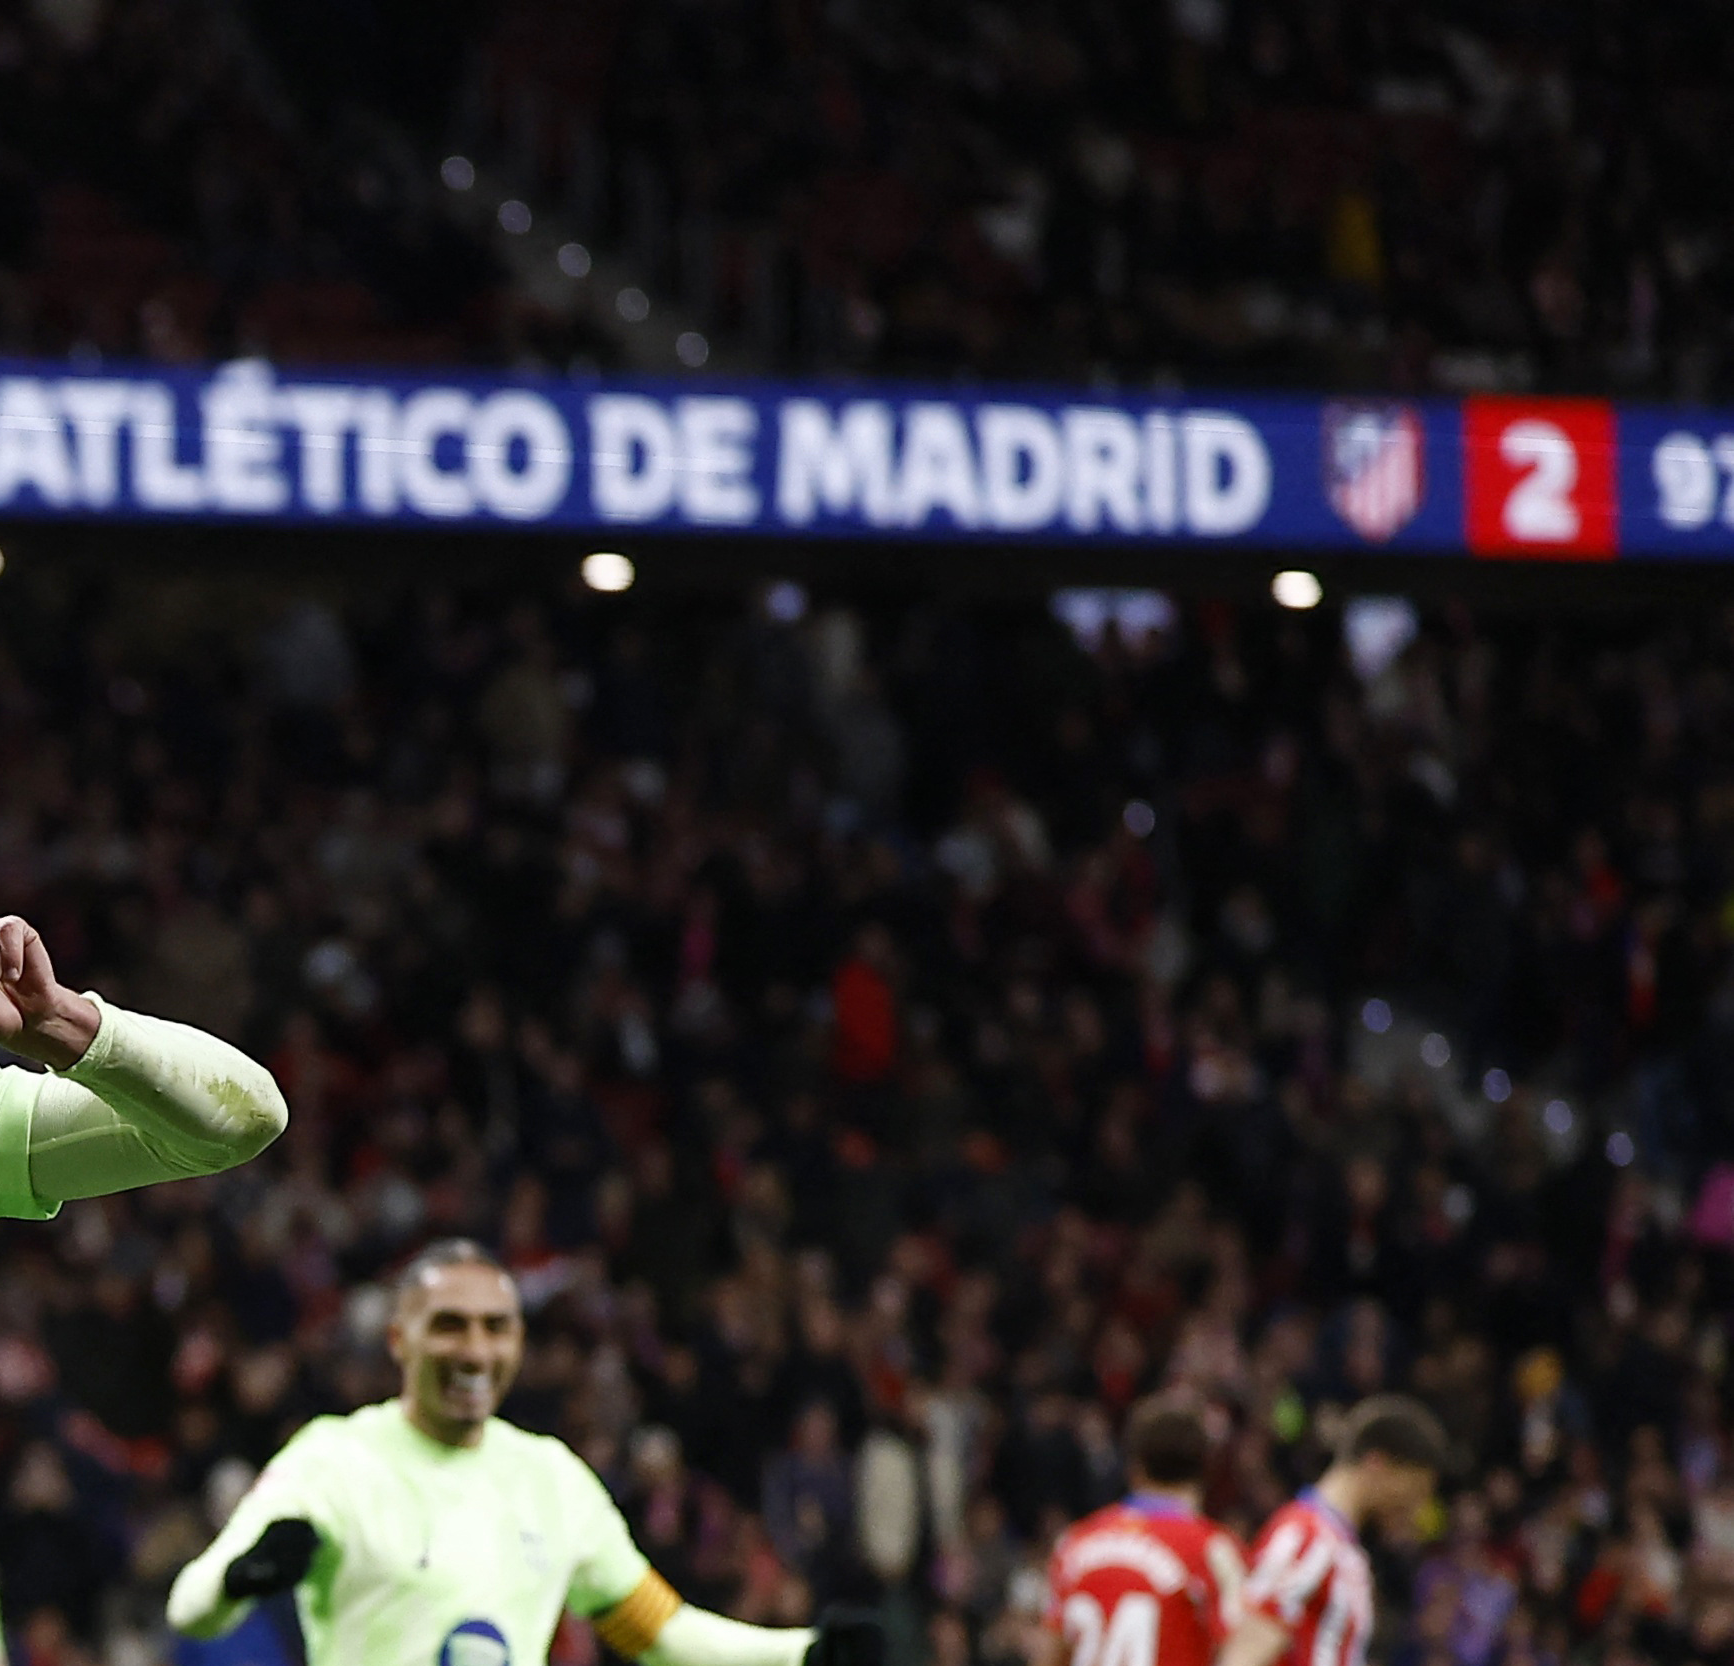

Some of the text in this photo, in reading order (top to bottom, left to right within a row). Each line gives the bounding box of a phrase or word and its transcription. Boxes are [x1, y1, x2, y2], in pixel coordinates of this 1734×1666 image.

[591, 392, 760, 526] DE
[775, 397, 1272, 536] MADRID
[1498, 417, 1583, 544] 2
